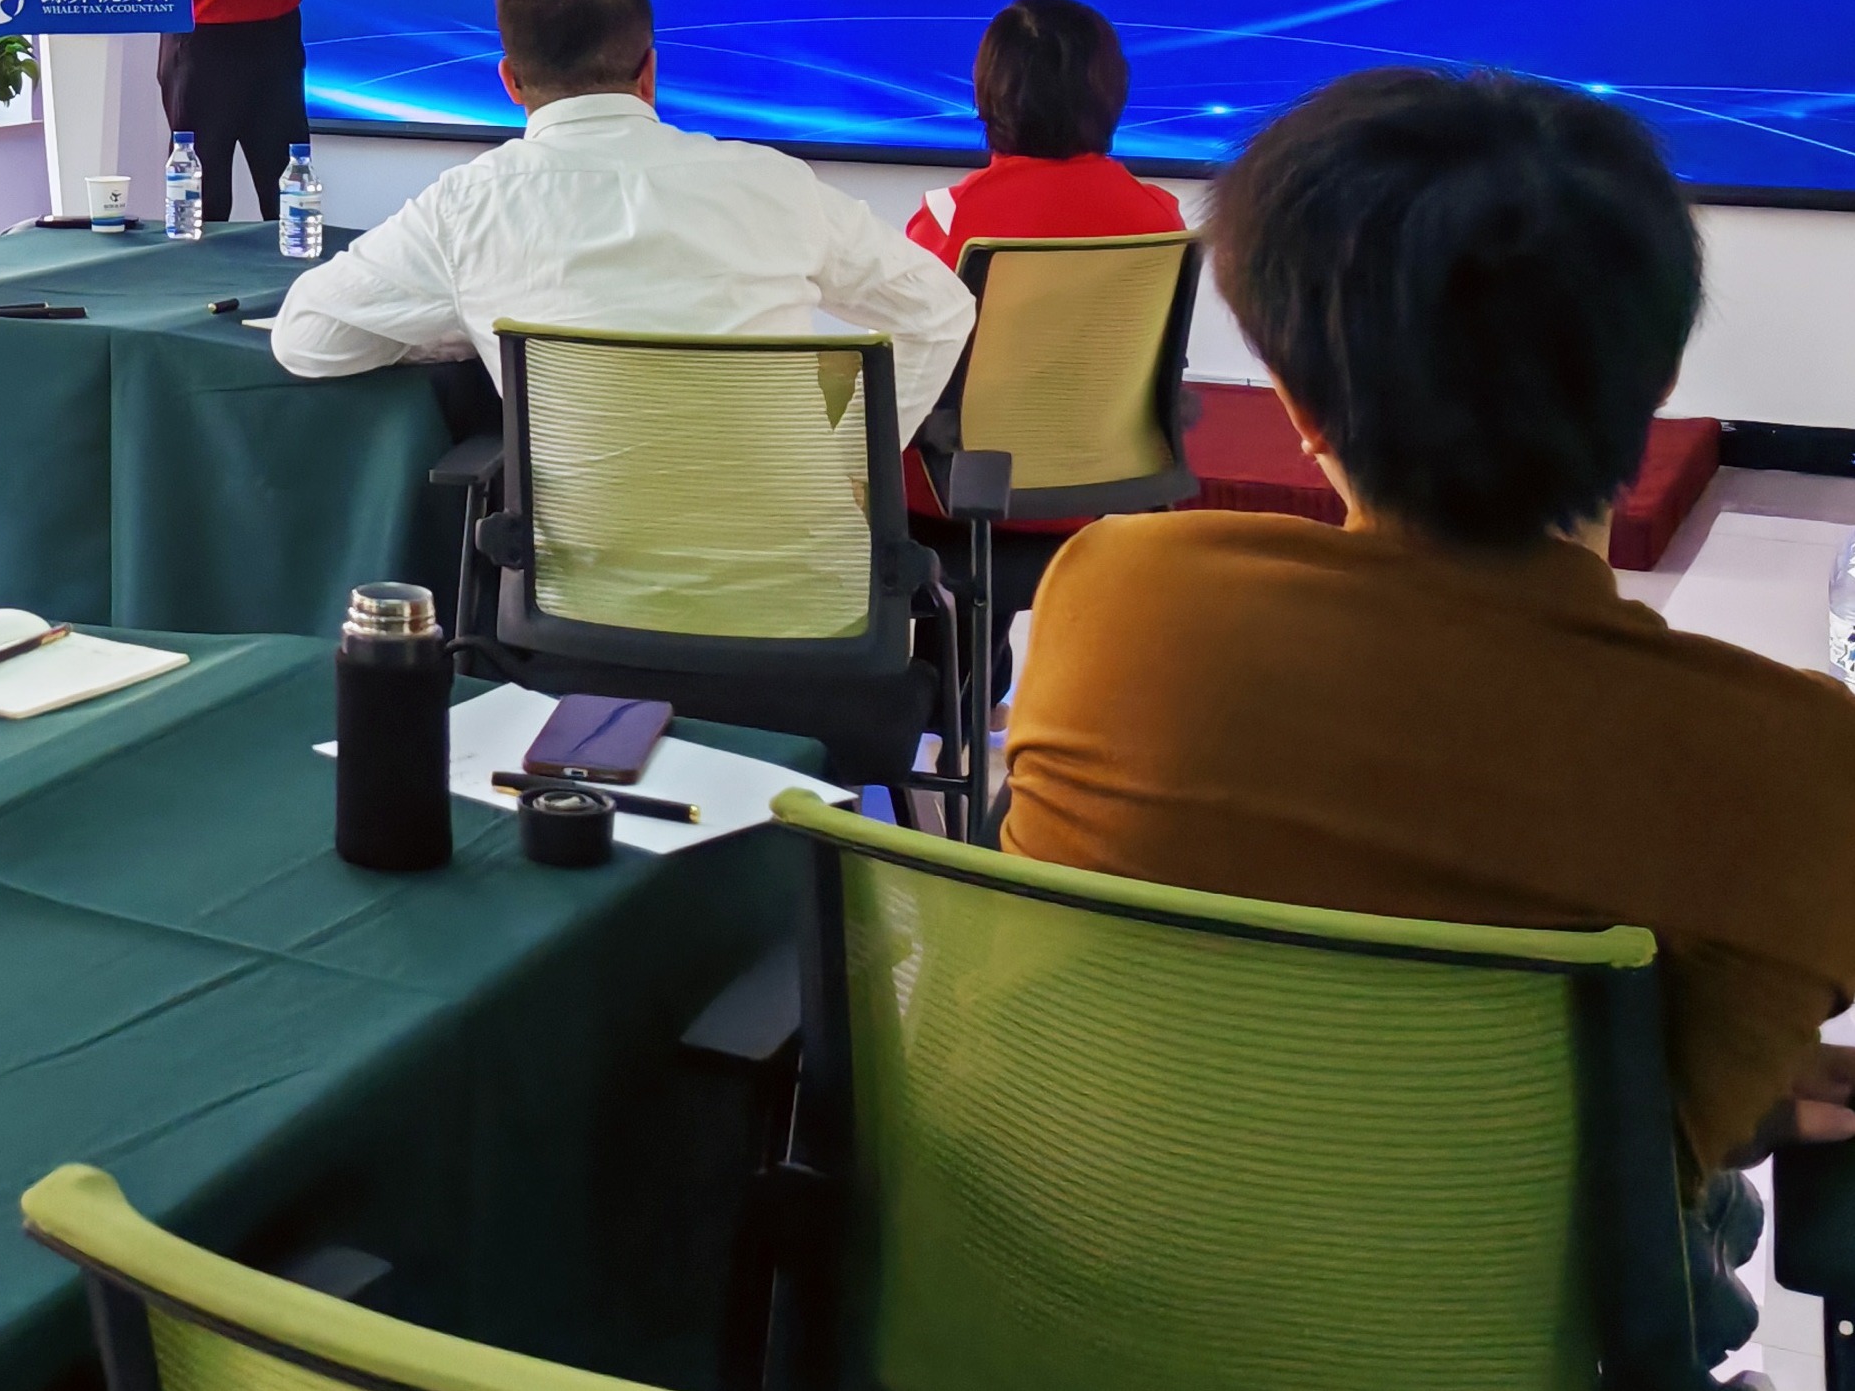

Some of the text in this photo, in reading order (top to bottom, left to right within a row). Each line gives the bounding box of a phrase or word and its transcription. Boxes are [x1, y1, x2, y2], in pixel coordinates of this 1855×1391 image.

[42, 4, 175, 15] WHALE TAX ACCOUNTANT
